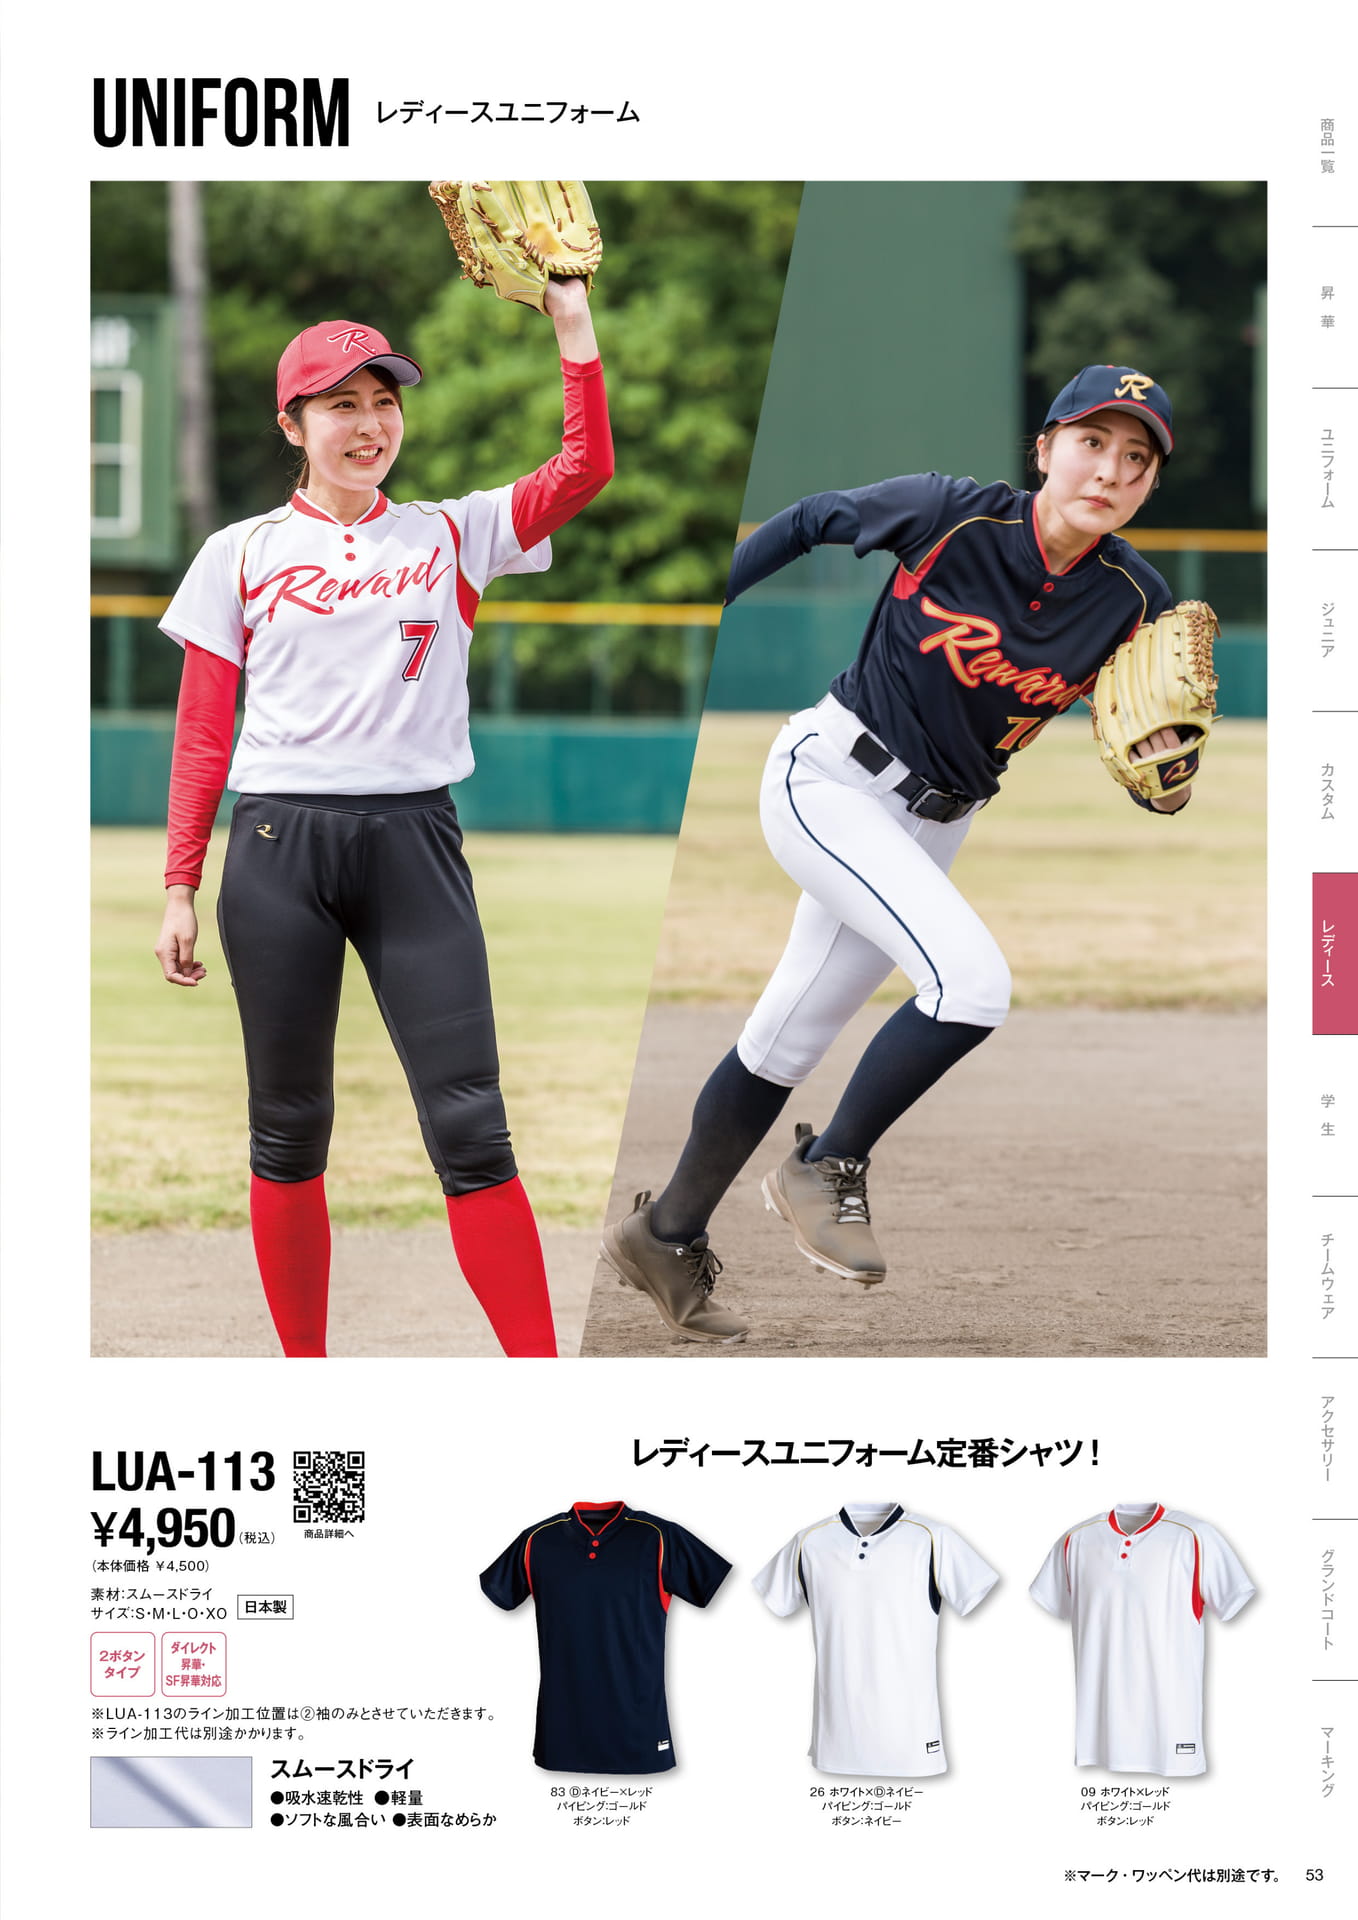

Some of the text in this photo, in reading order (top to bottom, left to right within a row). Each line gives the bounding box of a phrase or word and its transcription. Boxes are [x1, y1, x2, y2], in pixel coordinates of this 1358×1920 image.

[93, 77, 350, 148] UNIFORM
[377, 99, 641, 125] レディースユニフォーム
[1320, 117, 1336, 174] 商品一覧
[1114, 373, 1155, 401] R
[1320, 428, 1335, 509] ユニフォーム
[247, 546, 452, 623] Reward
[1320, 602, 1335, 658] ジュニア
[399, 620, 439, 681] 7
[1320, 762, 1335, 820] カスタム
[1321, 919, 1336, 987] レディース
[1320, 1233, 1336, 1320] チームウェア
[1320, 1396, 1335, 1482] アクセサリー
[632, 1436, 1099, 1469] レディースユニフォーム定番シャツ！
[92, 1450, 276, 1492] LUA-113
[90, 1507, 276, 1556] ¥4,950 (税込)
[303, 1528, 355, 1540] 商品詳細へ
[90, 1586, 213, 1602] 素材:スムースドライ
[1321, 1549, 1335, 1651] グランドコート
[245, 1599, 288, 1615] 日本製
[99, 1649, 146, 1663] 2ボタン
[170, 1641, 217, 1655] ダイレクト
[104, 1665, 142, 1680] タイプ
[165, 1673, 222, 1688] SF昇華対応
[91, 1725, 305, 1741] ※ライン加工代は別途かかります。
[270, 1758, 415, 1780] スムースドライ
[1320, 1727, 1335, 1798] マーキング
[550, 1786, 566, 1798] 83
[809, 1786, 826, 1798] 26
[1080, 1786, 1096, 1798] 09
[556, 1800, 648, 1812] パイピング:ゴールド
[821, 1800, 913, 1812] パイピング:ゴールド
[1080, 1800, 1171, 1812] パイピング:ゴールド
[573, 1815, 631, 1827] ボタン:レッド
[831, 1815, 902, 1827] ボタン:ネイビー
[1096, 1815, 1155, 1827] ボタン:レッド
[1064, 1867, 1280, 1884] ※マーク・ワッペン代は別途です。
[1305, 1868, 1324, 1882] 53
